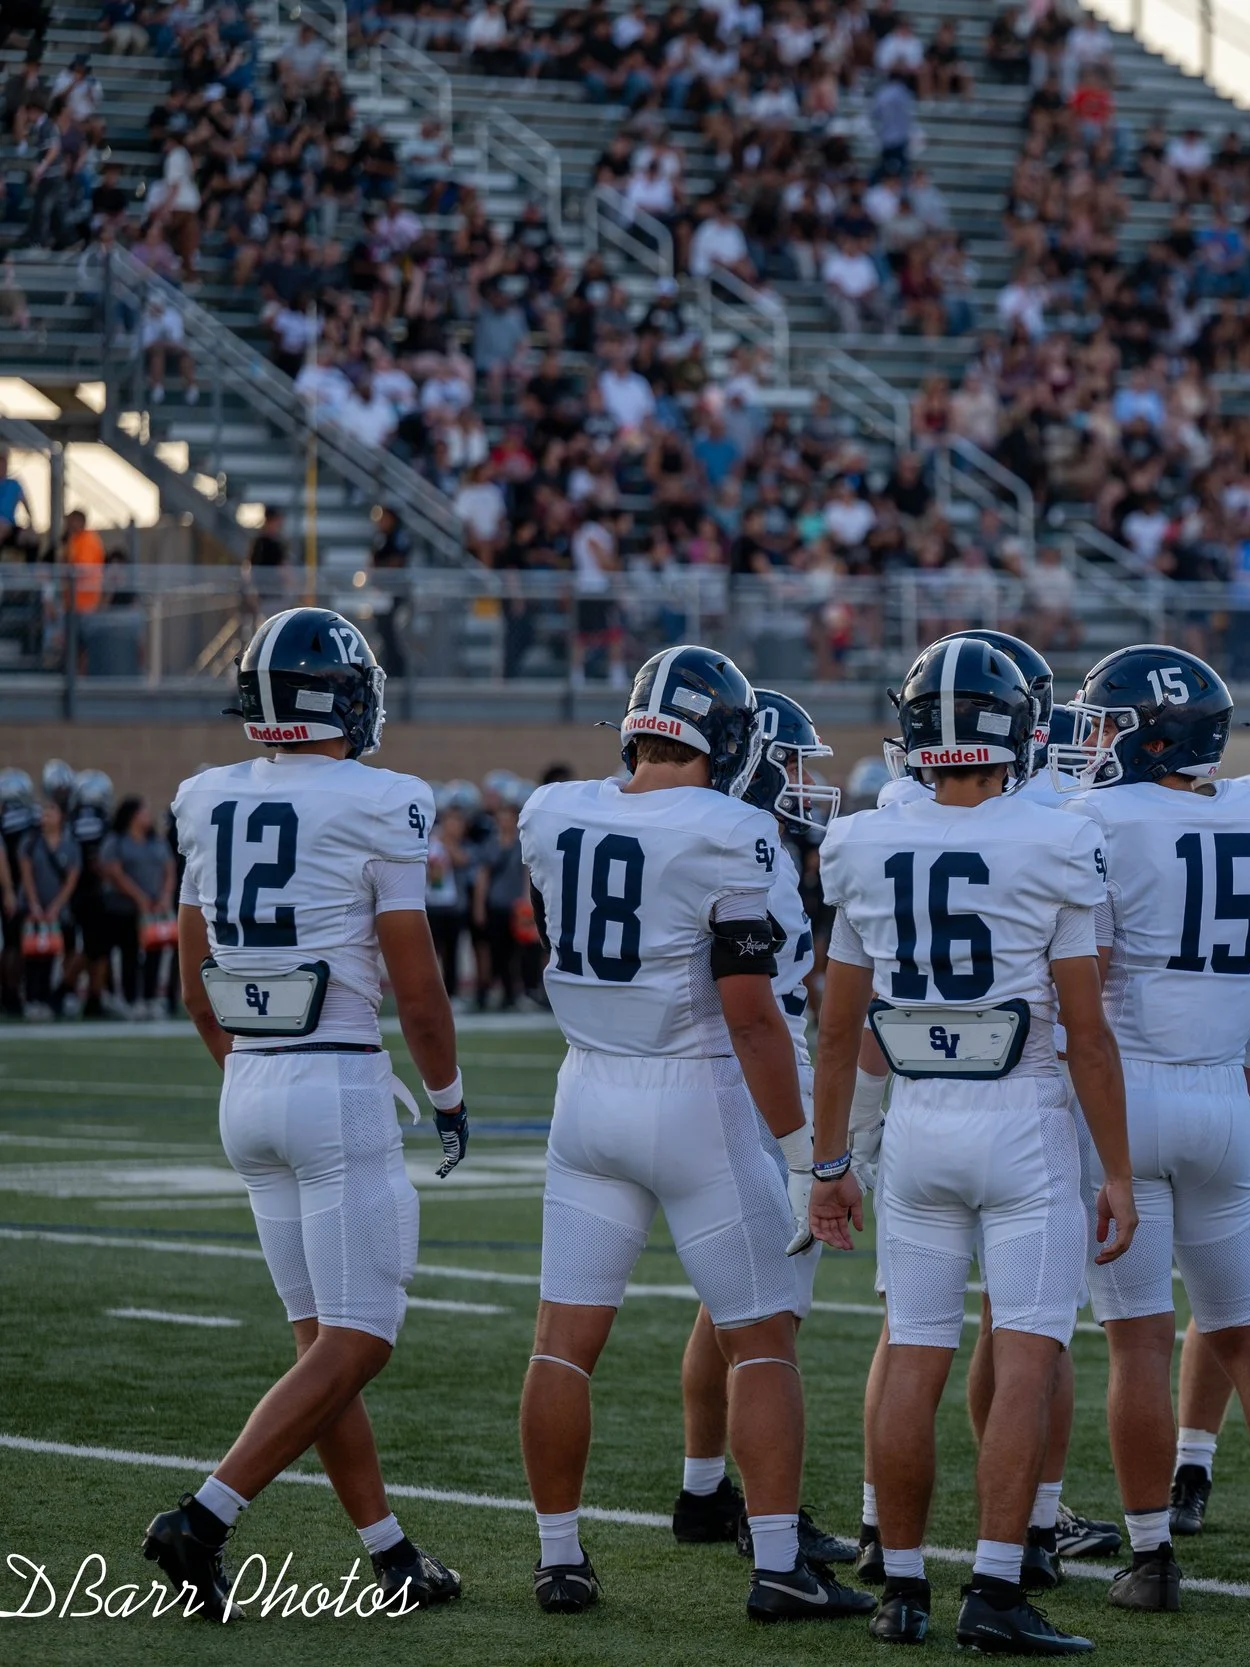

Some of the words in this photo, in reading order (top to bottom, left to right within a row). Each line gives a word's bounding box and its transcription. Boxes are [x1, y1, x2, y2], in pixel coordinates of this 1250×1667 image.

[329, 628, 364, 664] 12
[1147, 667, 1190, 706] 15
[250, 725, 309, 741] Riddell
[625, 716, 682, 736] Riddell
[921, 748, 989, 765] Riddell
[409, 803, 426, 839] SV
[755, 838, 775, 873] SV
[211, 801, 299, 947] 12
[556, 827, 645, 982] 18
[884, 851, 995, 1001] 16
[245, 983, 270, 1016] SV
[929, 1026, 961, 1058] SV
